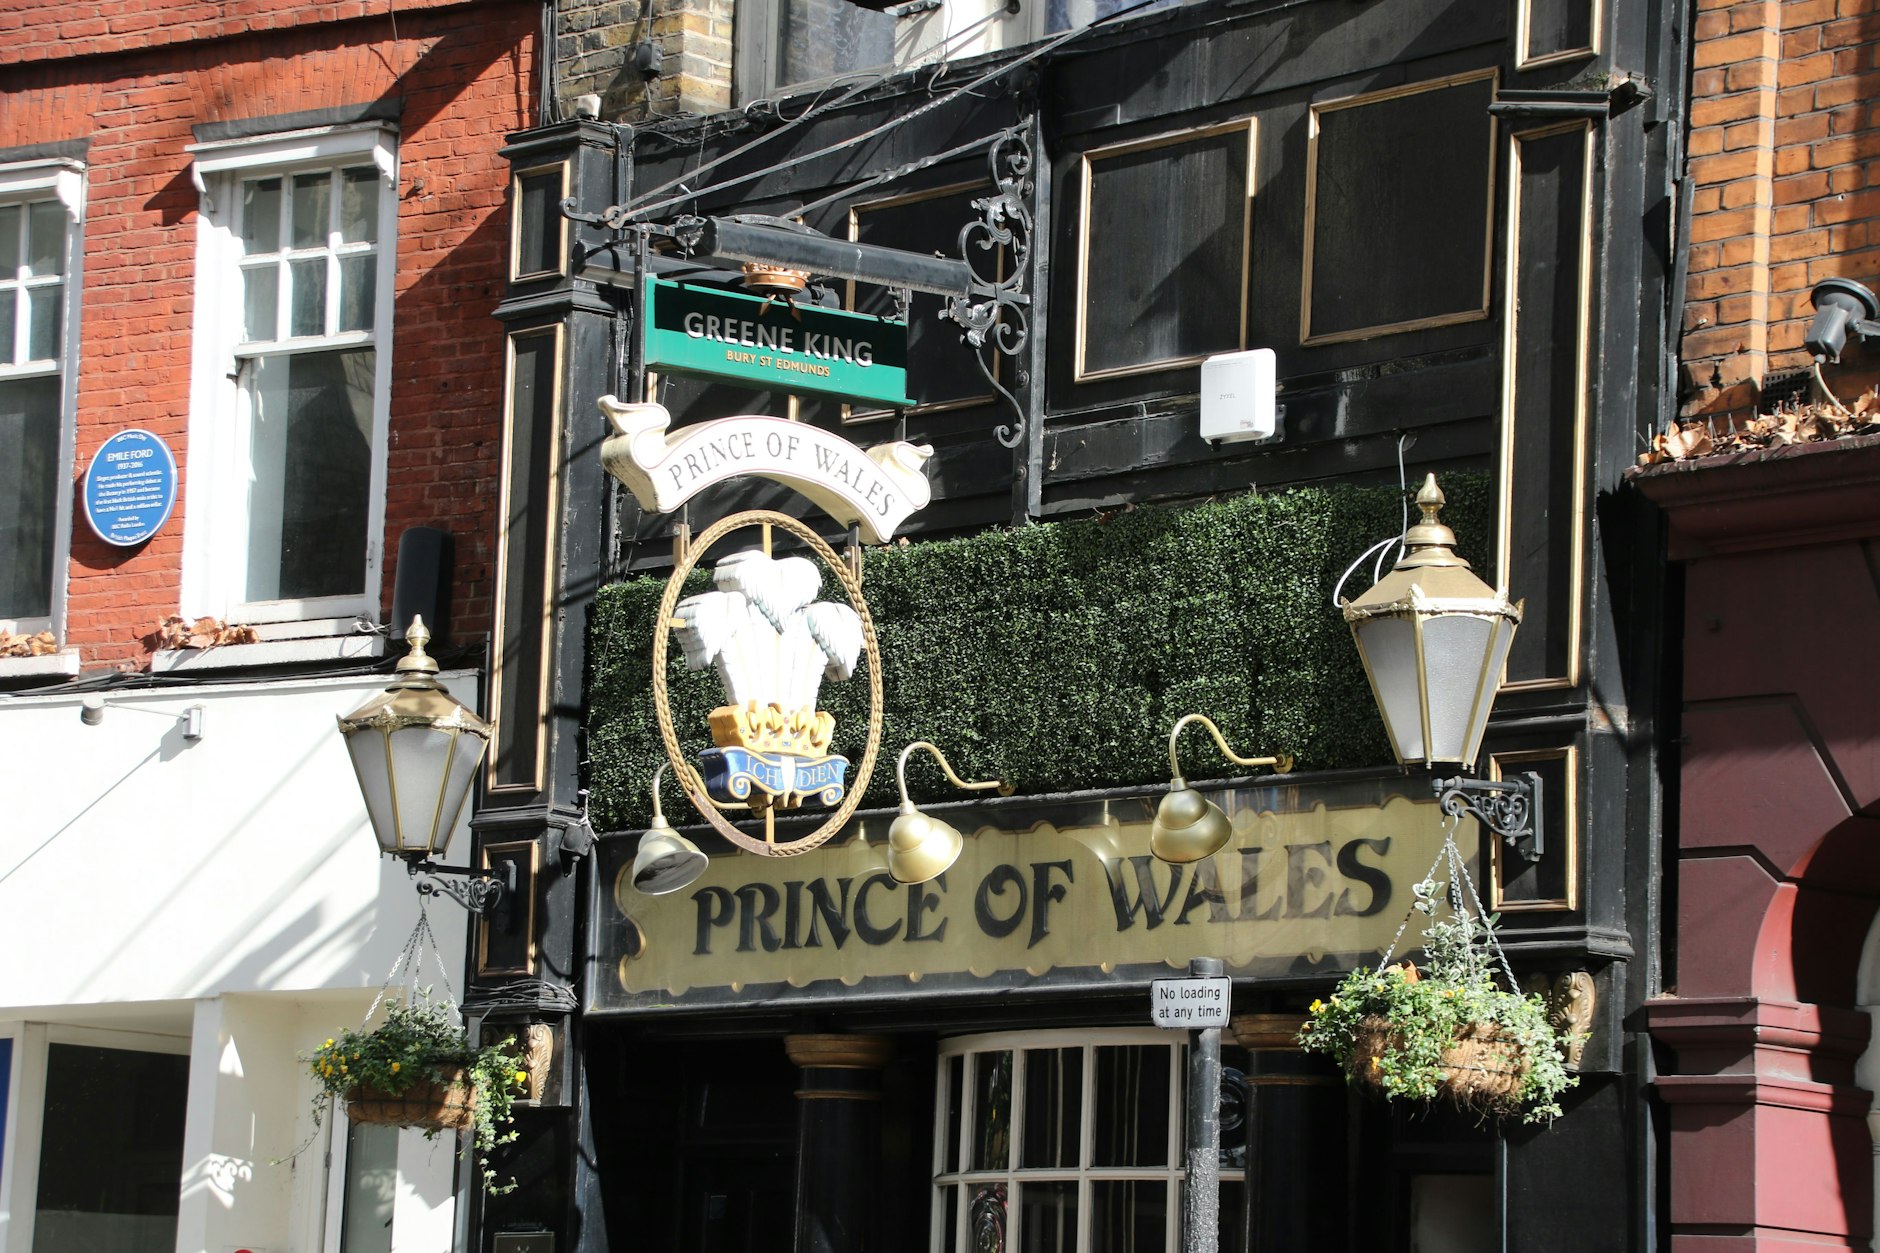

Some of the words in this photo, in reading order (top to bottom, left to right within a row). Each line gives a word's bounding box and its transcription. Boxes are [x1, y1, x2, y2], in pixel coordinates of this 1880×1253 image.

[684, 312, 794, 354] GREENE
[804, 331, 873, 367] KING
[726, 349, 757, 364] BURY
[759, 356, 772, 367] ST
[775, 359, 831, 378] EDMUNDS
[107, 451, 129, 462] EMILE
[130, 449, 153, 459] FORD
[668, 432, 756, 491] PRINCE
[766, 432, 800, 461] OF
[814, 443, 896, 517] WALES
[745, 755, 778, 786] ICH
[799, 763, 840, 787] DIEN
[691, 872, 950, 955] PRINCE
[973, 859, 1075, 950] OF
[1102, 837, 1393, 932] WALES
[1160, 987, 1176, 1000] No
[1180, 986, 1221, 1000] loading
[1159, 1006, 1170, 1018] at
[1174, 1007, 1193, 1020] any
[1198, 1005, 1222, 1017] time
